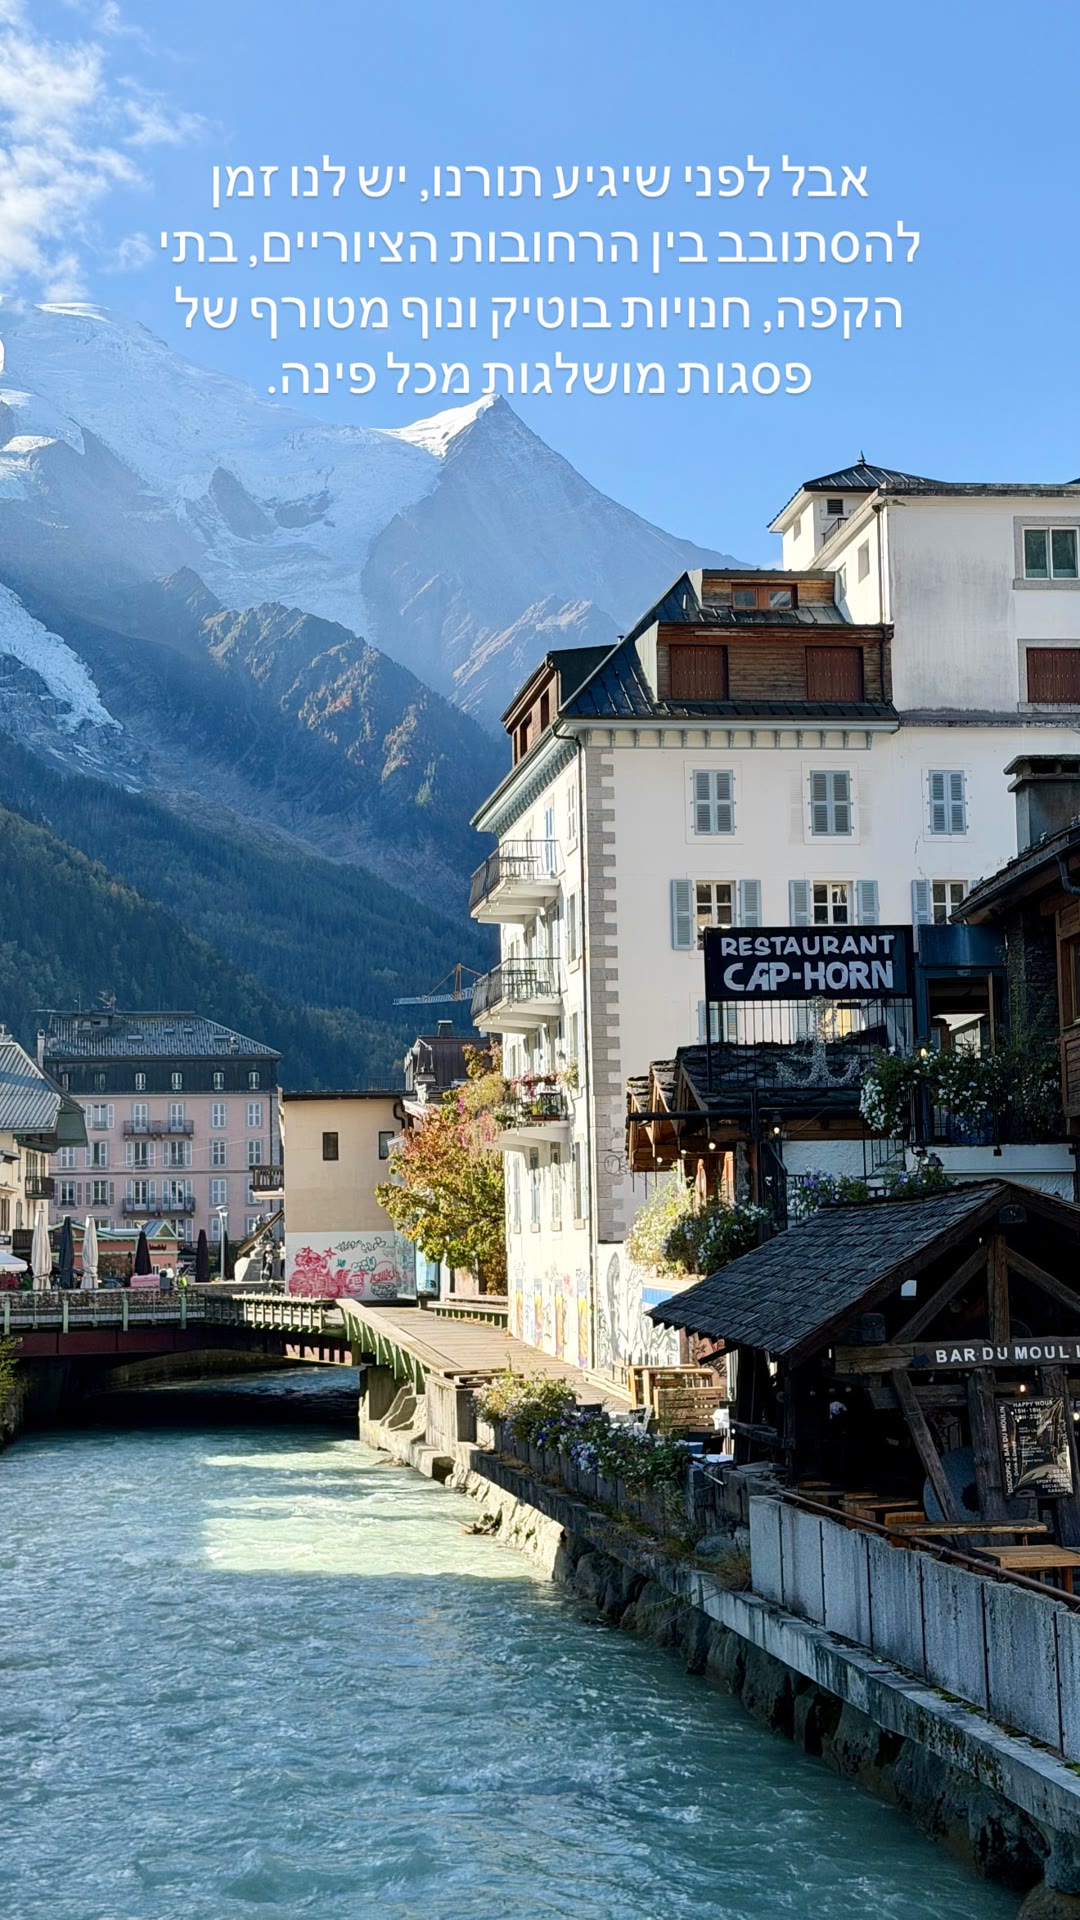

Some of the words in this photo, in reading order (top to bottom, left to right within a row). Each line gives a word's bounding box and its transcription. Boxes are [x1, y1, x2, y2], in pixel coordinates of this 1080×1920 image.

[721, 935, 895, 957] RESTAURANT
[723, 960, 894, 991] CAP-HORN
[935, 1348, 976, 1363] BAR
[982, 1347, 1008, 1361] DU
[1002, 1432, 1008, 1443] DU
[1005, 1462, 1013, 1493] DISCOPIC
